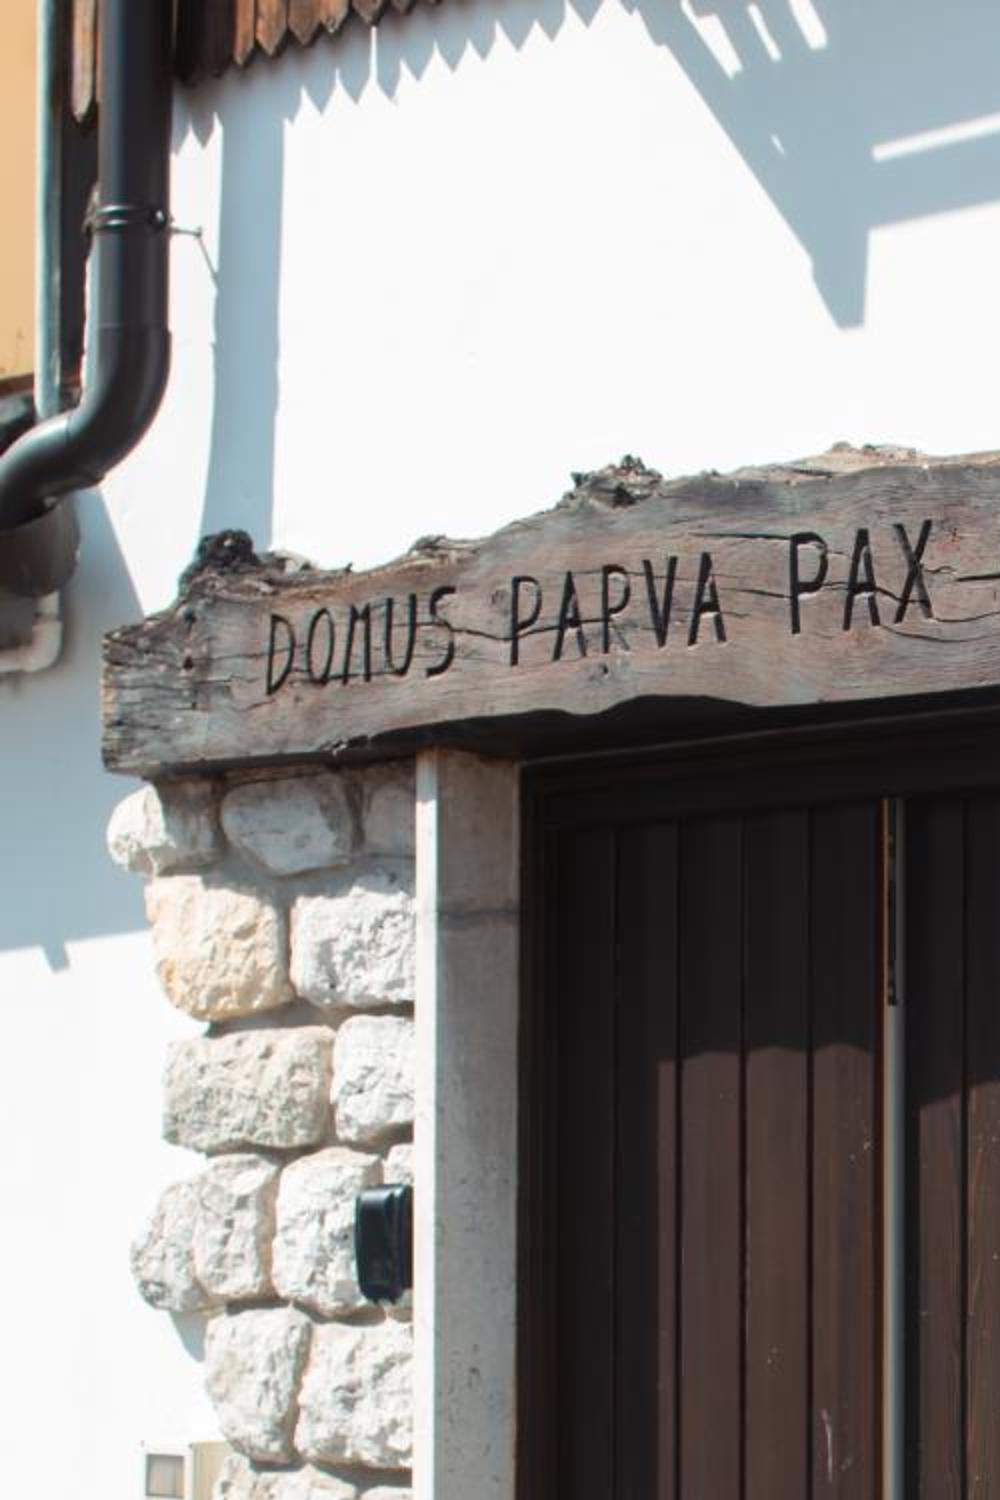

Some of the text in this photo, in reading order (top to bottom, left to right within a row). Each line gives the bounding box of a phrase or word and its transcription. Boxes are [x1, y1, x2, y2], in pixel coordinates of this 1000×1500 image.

[266, 585, 457, 696] DOMUS
[510, 551, 727, 667] PARVA
[789, 518, 934, 634] PAX
